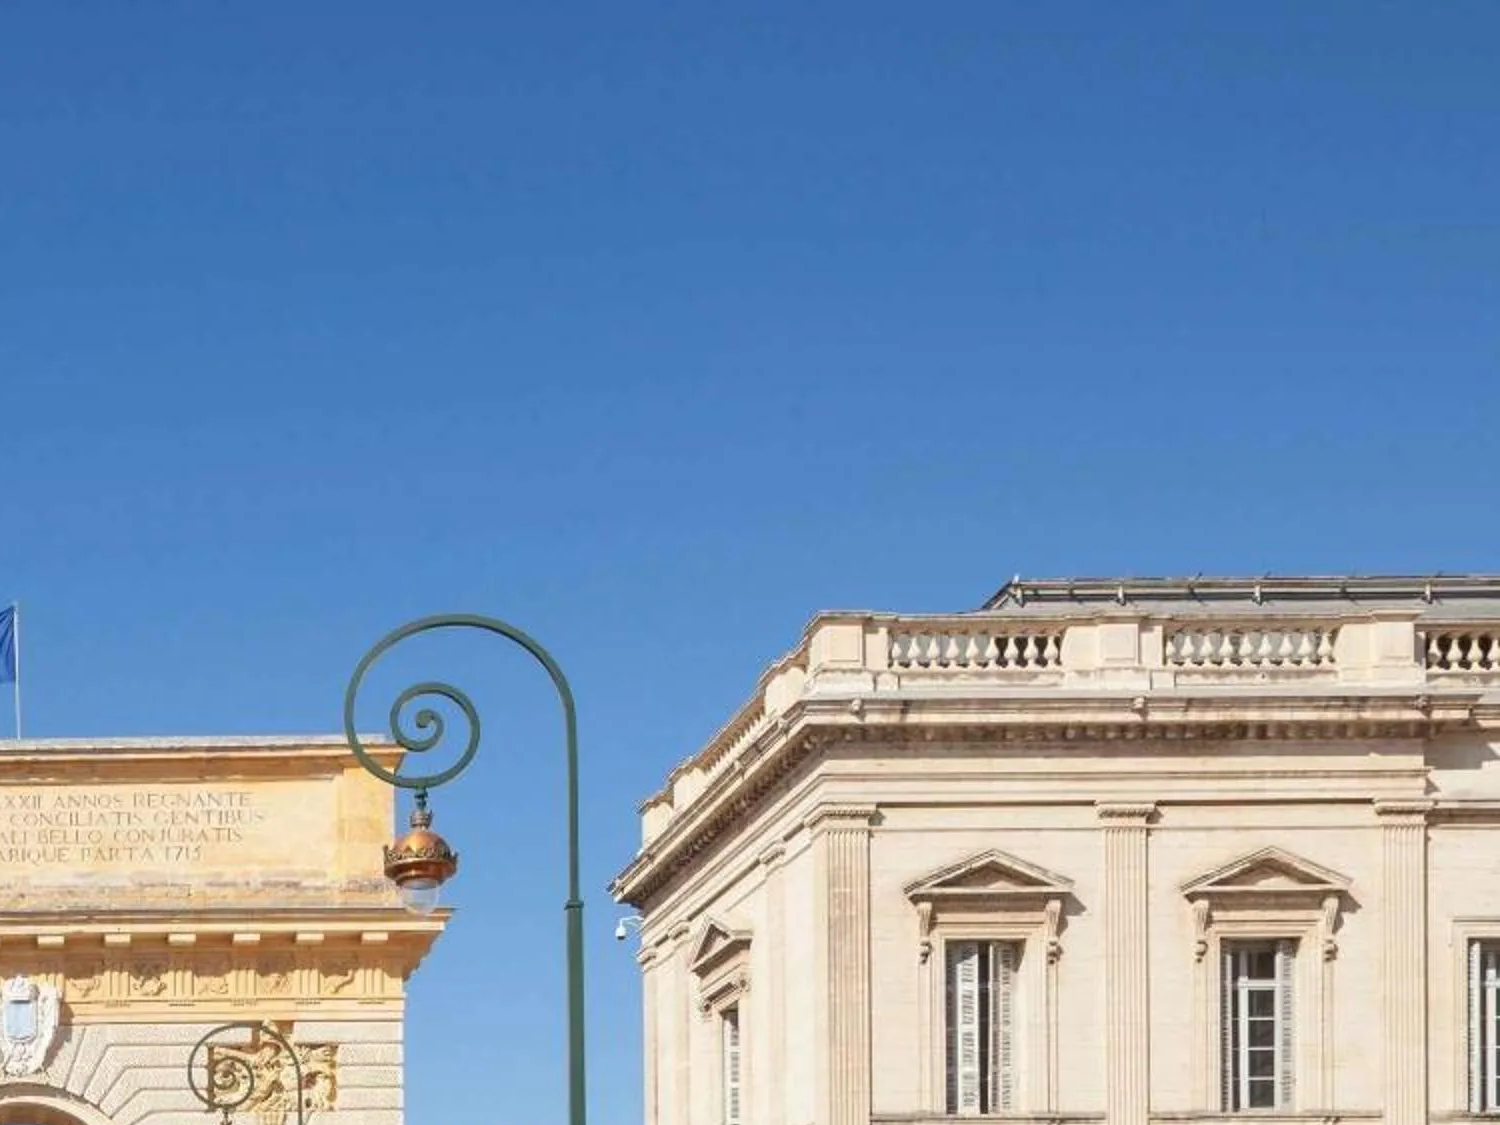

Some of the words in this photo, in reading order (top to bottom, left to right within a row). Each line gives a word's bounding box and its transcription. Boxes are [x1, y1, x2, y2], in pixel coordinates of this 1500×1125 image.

[54, 793, 124, 809] ANNOS
[132, 792, 253, 808] REGNANTE
[37, 829, 103, 845] BELLO
[80, 846, 153, 863] PARTA
